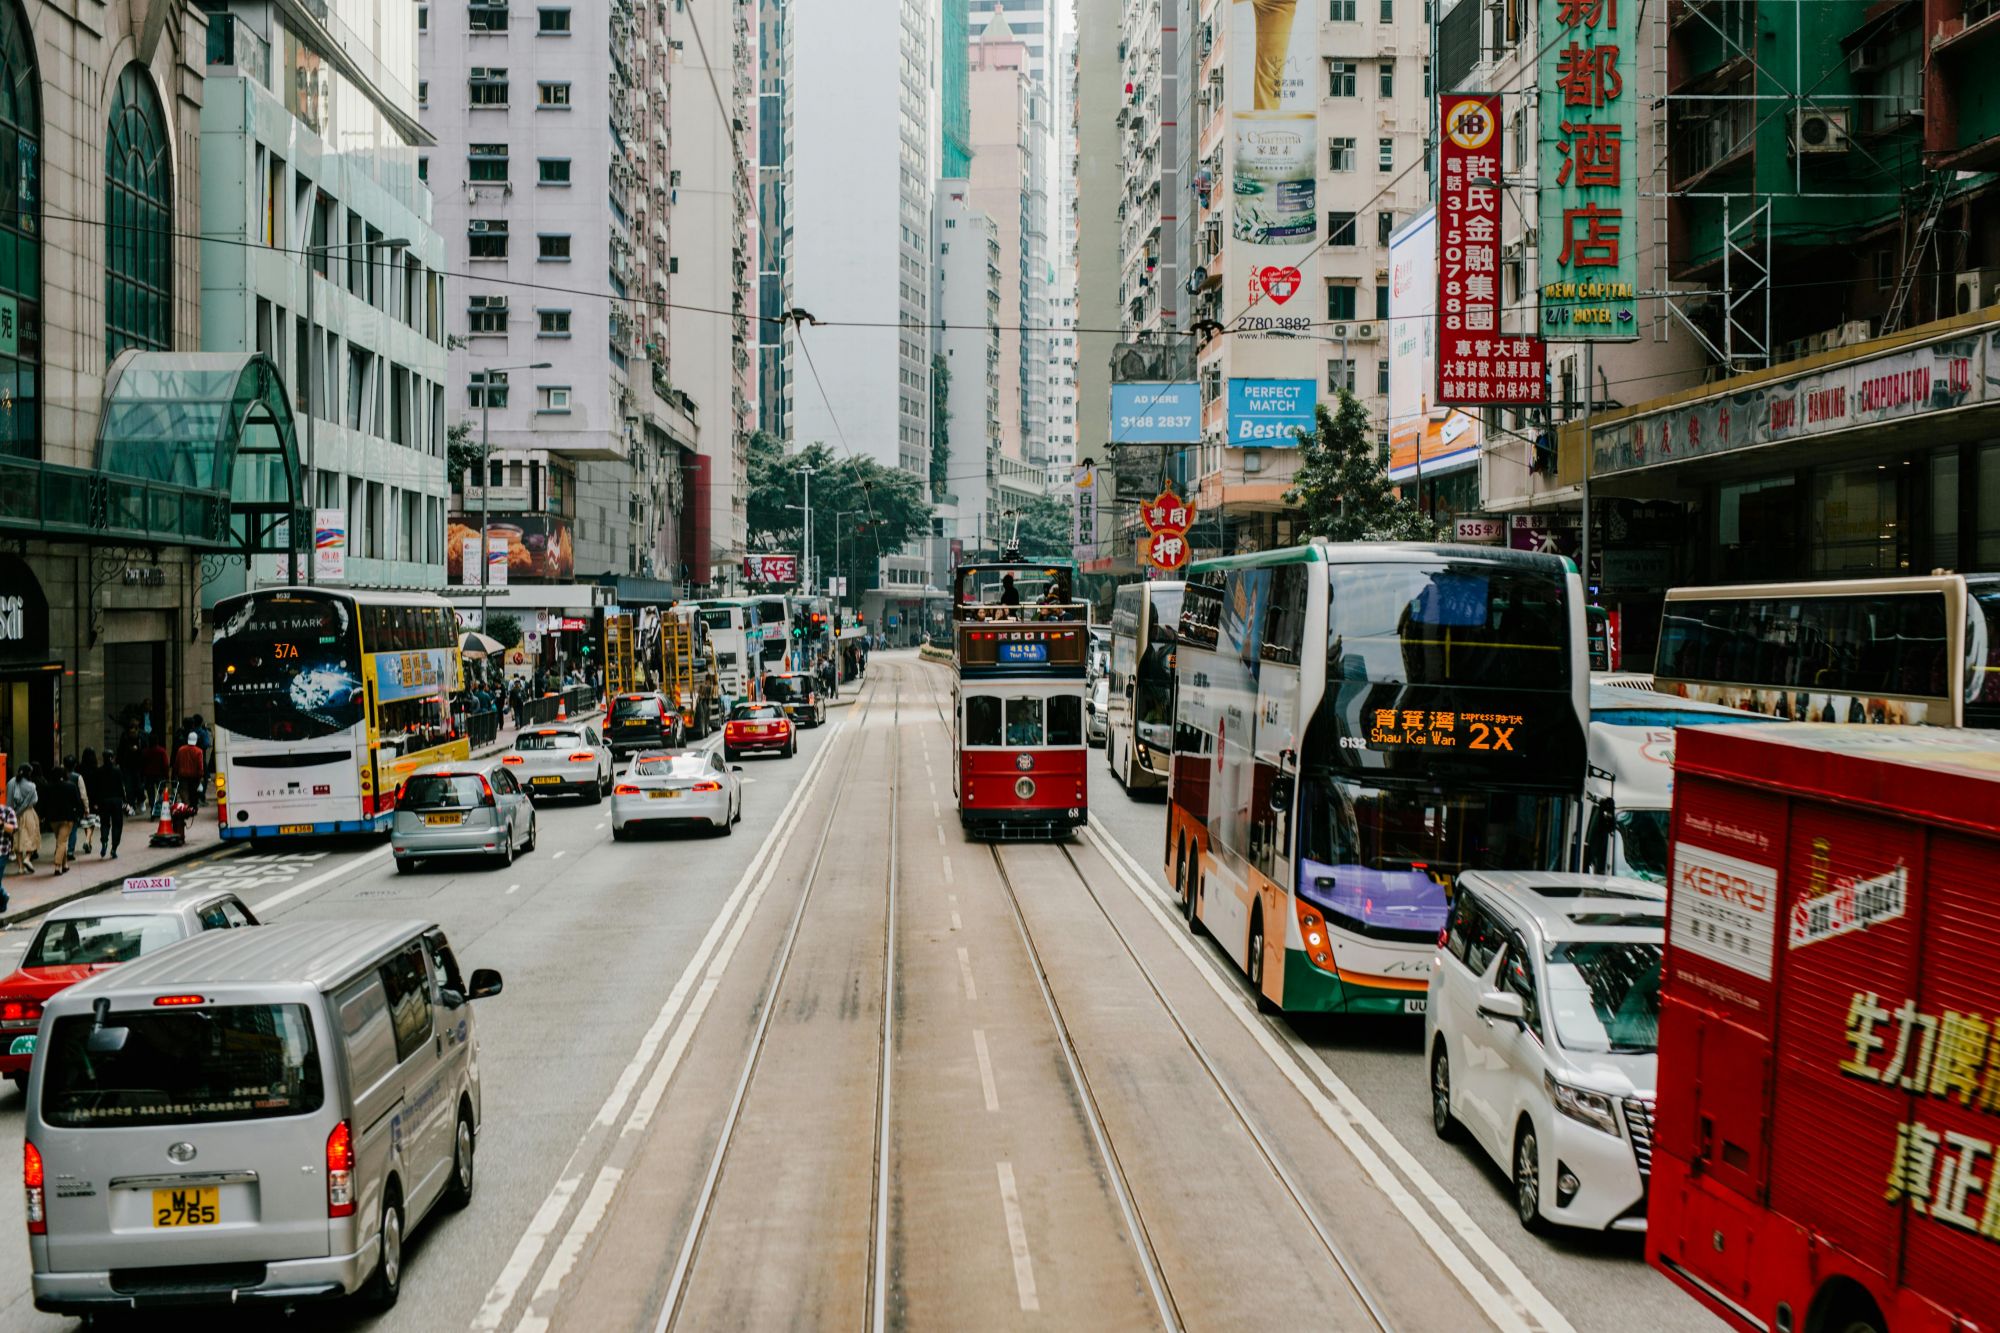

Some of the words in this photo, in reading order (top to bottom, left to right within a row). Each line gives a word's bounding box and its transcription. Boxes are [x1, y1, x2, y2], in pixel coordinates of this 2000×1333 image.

[1446, 157, 1462, 193] 電話
[1465, 155, 1496, 332] 許氏金融集團
[1446, 195, 1462, 331] 31507888
[1545, 283, 1576, 299] NEW
[1578, 282, 1633, 299] CAPITAL
[1238, 317, 1273, 331] 2780
[1276, 317, 1311, 331] 3882
[1572, 307, 1612, 324] HOTEL
[1455, 339, 1531, 359] 專營大陸
[1443, 360, 1541, 380] 大筆貸款、股票買賣
[1244, 386, 1301, 399] PERFECT
[1808, 385, 1846, 424] BANKING
[1861, 366, 1930, 413] CORPORATION
[1949, 357, 1972, 395] LTD.
[1133, 395, 1149, 405] AD
[1151, 395, 1179, 405] HERE
[1249, 399, 1296, 412] MATCH
[1157, 416, 1192, 428] 2837
[1459, 523, 1482, 537] $35
[1152, 534, 1183, 566] 押
[764, 560, 794, 571] KFC
[291, 618, 323, 629] MARK
[274, 643, 299, 659] 37A
[1339, 736, 1367, 750] 6132
[1371, 728, 1401, 744] Shau
[1406, 730, 1427, 745] Kei
[1431, 731, 1456, 746] Wan
[1468, 722, 1515, 752] 2X
[427, 815, 438, 824] AL
[1068, 807, 1079, 818] 68
[1714, 819, 1757, 845] distributed
[180, 862, 314, 880] BUS
[127, 878, 171, 890] TAXI
[1682, 860, 1769, 914] KERRY
[1409, 1000, 1427, 1012] UU
[171, 1190, 200, 1212] MJ
[158, 1206, 216, 1226] 2765
